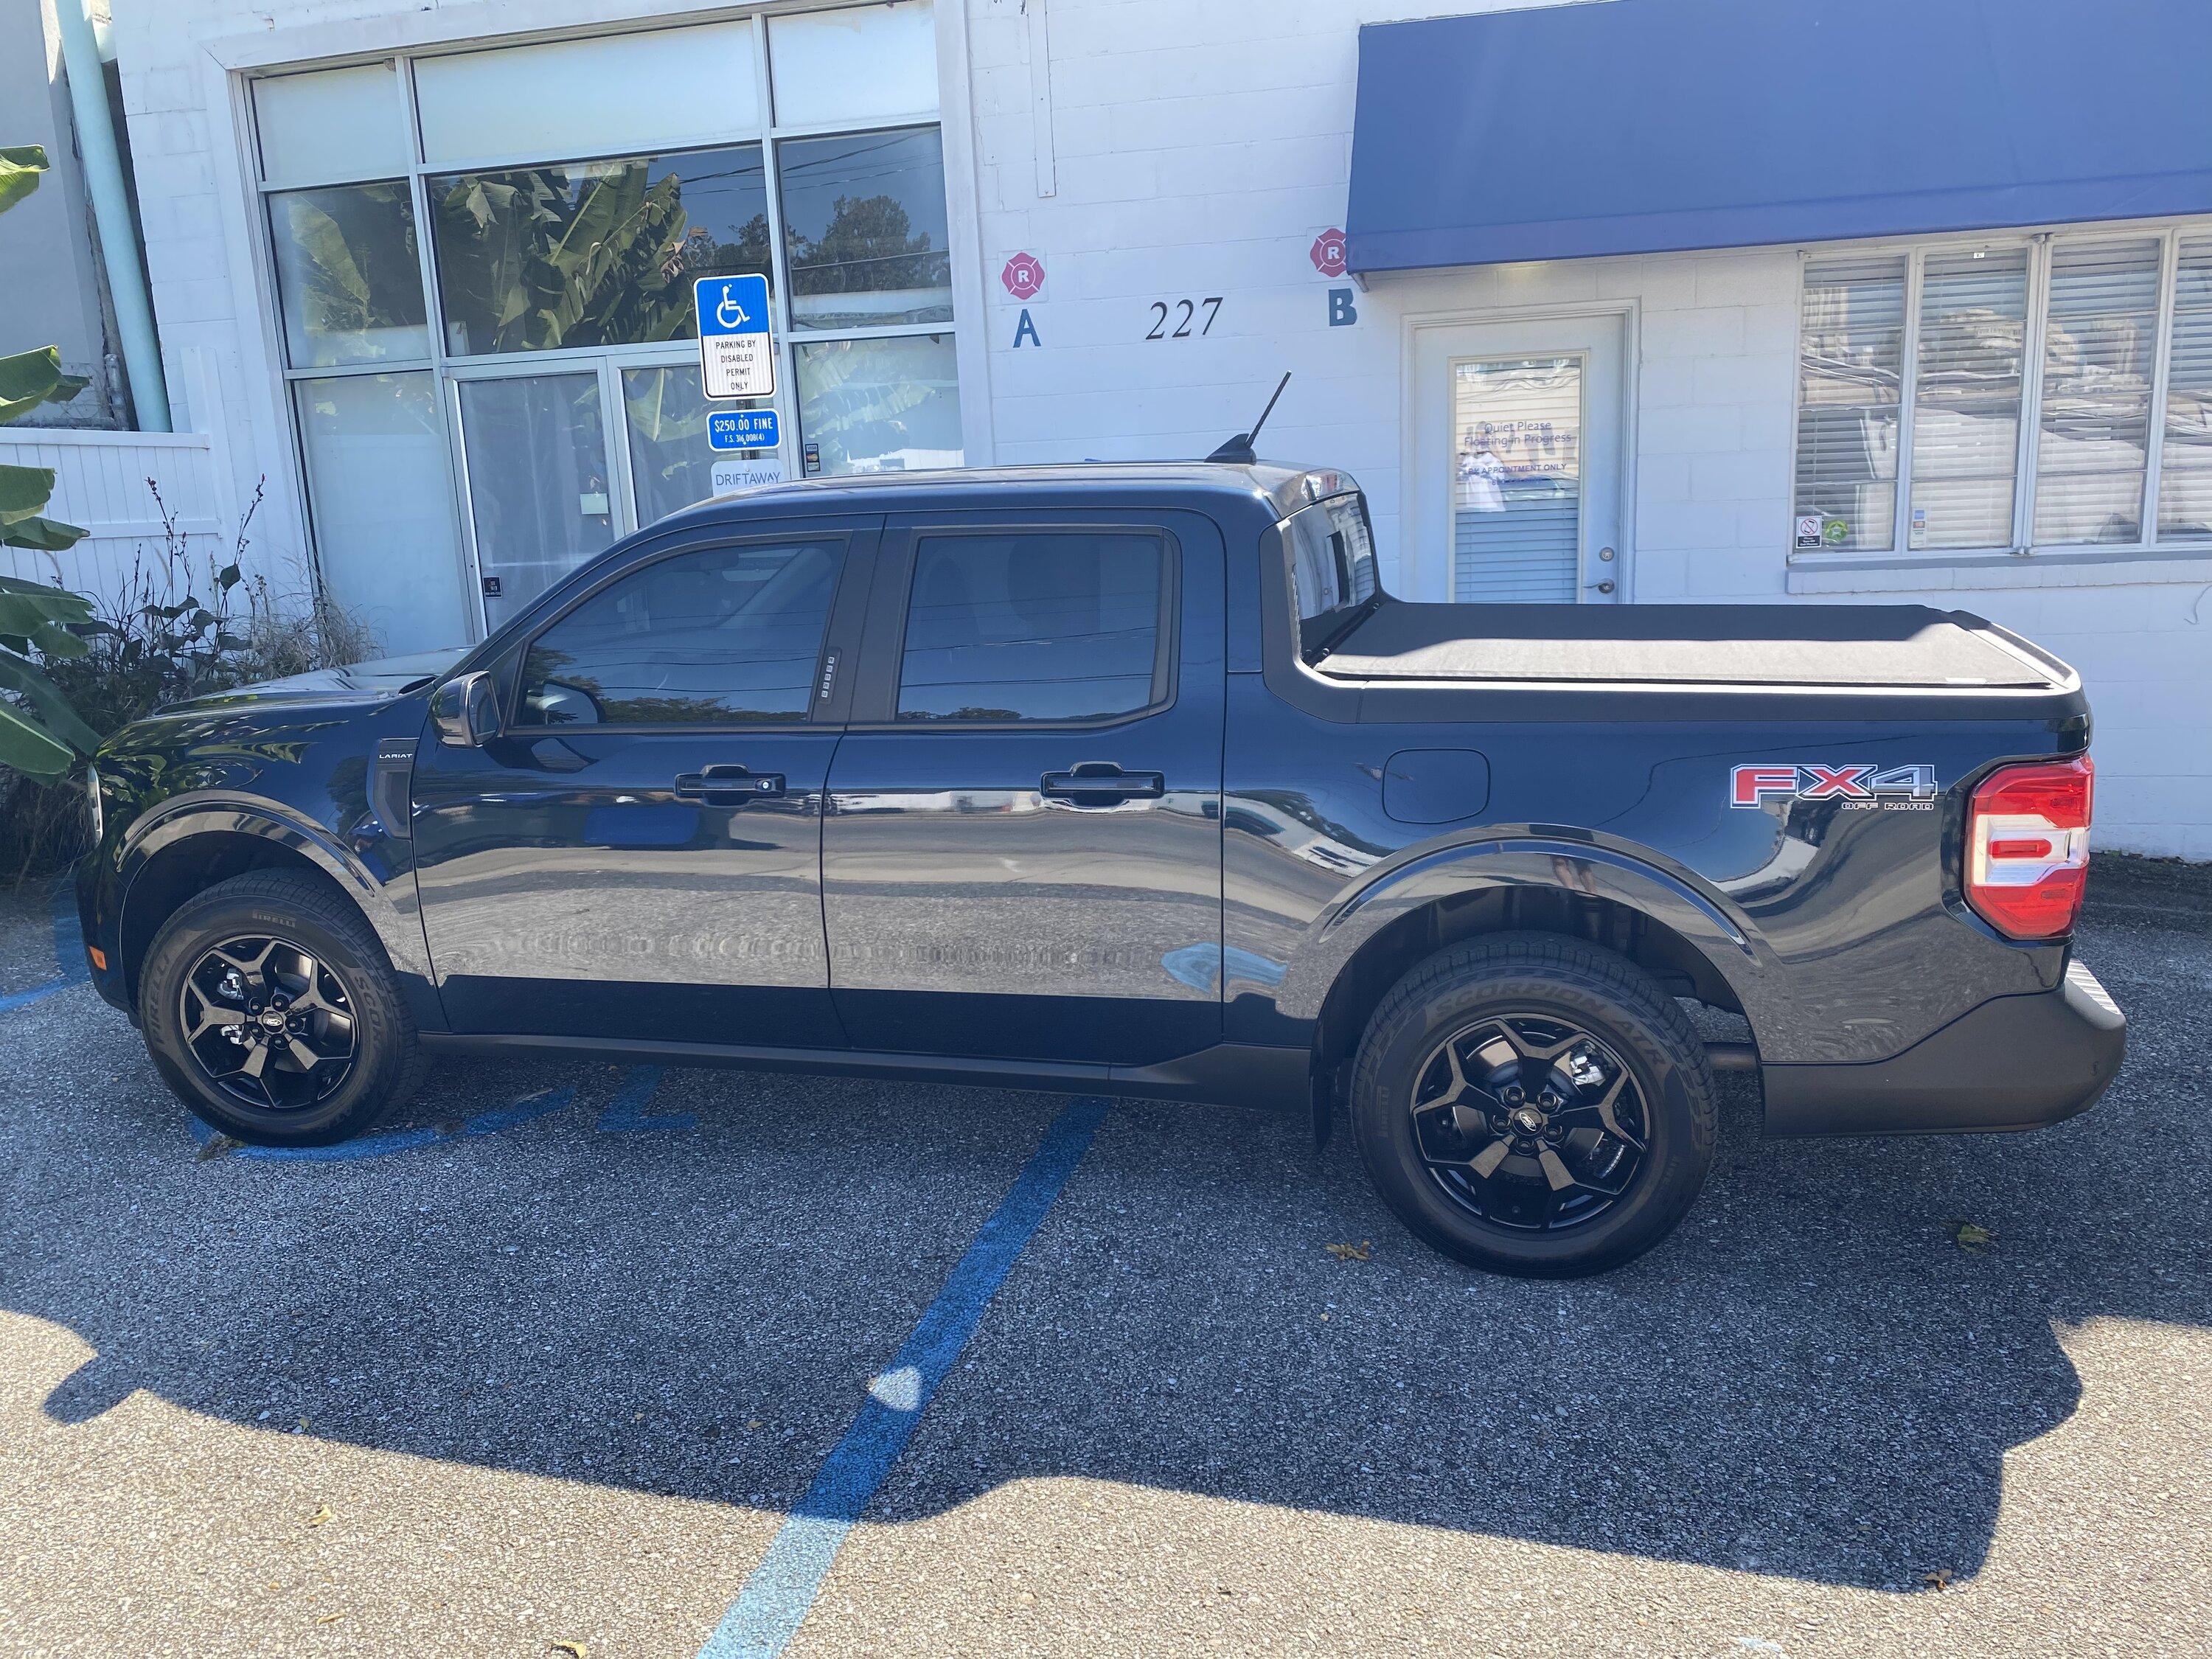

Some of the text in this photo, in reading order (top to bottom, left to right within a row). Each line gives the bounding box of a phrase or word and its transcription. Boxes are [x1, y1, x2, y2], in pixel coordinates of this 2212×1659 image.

[1328, 246, 1340, 260] R
[1018, 269, 1029, 283] R
[1328, 288, 1357, 327] B
[1145, 297, 1223, 340] 227
[1012, 308, 1041, 348] A
[715, 339, 756, 349] PARKING BY
[720, 354, 754, 364] DISABLED
[726, 367, 751, 377] PERMIT
[730, 381, 748, 390] ONLY
[714, 417, 773, 434] $250.00 FINE
[1484, 421, 1551, 435] Quiet Please
[1524, 434, 1572, 446] Progress
[1482, 465, 1542, 473] APPOINTMENT
[1543, 463, 1568, 472] ONLY
[715, 472, 781, 486] DRIFTAWAY
[1731, 764, 1938, 809] FX4
[1842, 801, 1934, 810] OFF ROAD
[1435, 981, 1608, 1015] SCORPION
